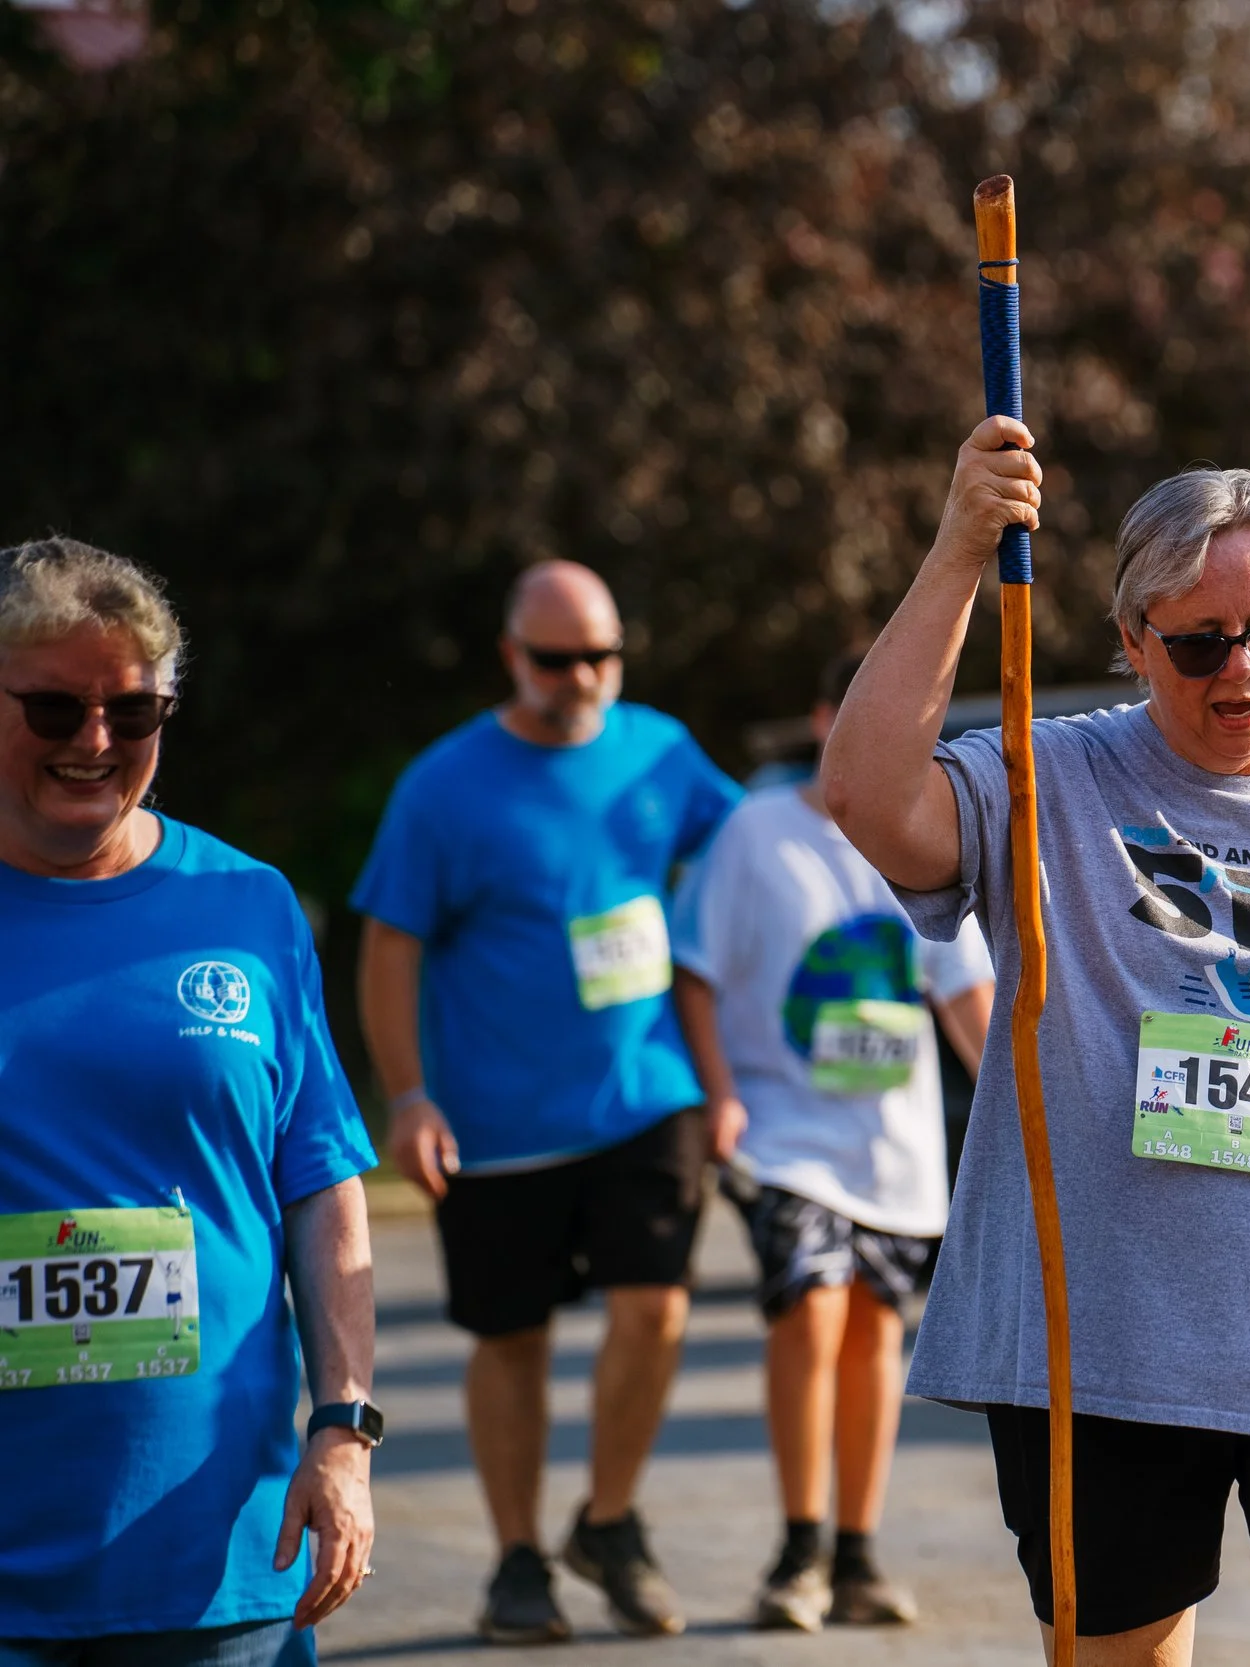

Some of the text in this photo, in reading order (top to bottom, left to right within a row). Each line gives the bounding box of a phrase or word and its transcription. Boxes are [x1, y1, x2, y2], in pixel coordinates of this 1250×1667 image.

[179, 1026, 213, 1037] HELP
[1164, 1070, 1186, 1082] CFR
[1140, 1100, 1169, 1114] RUN
[1164, 1130, 1173, 1140] A
[1142, 1140, 1192, 1159] 1548
[1231, 1140, 1240, 1149] B
[8, 1258, 154, 1322] 1537
[56, 1362, 114, 1384] 1537
[136, 1357, 190, 1378] 1537
[0, 1368, 32, 1387] 37
